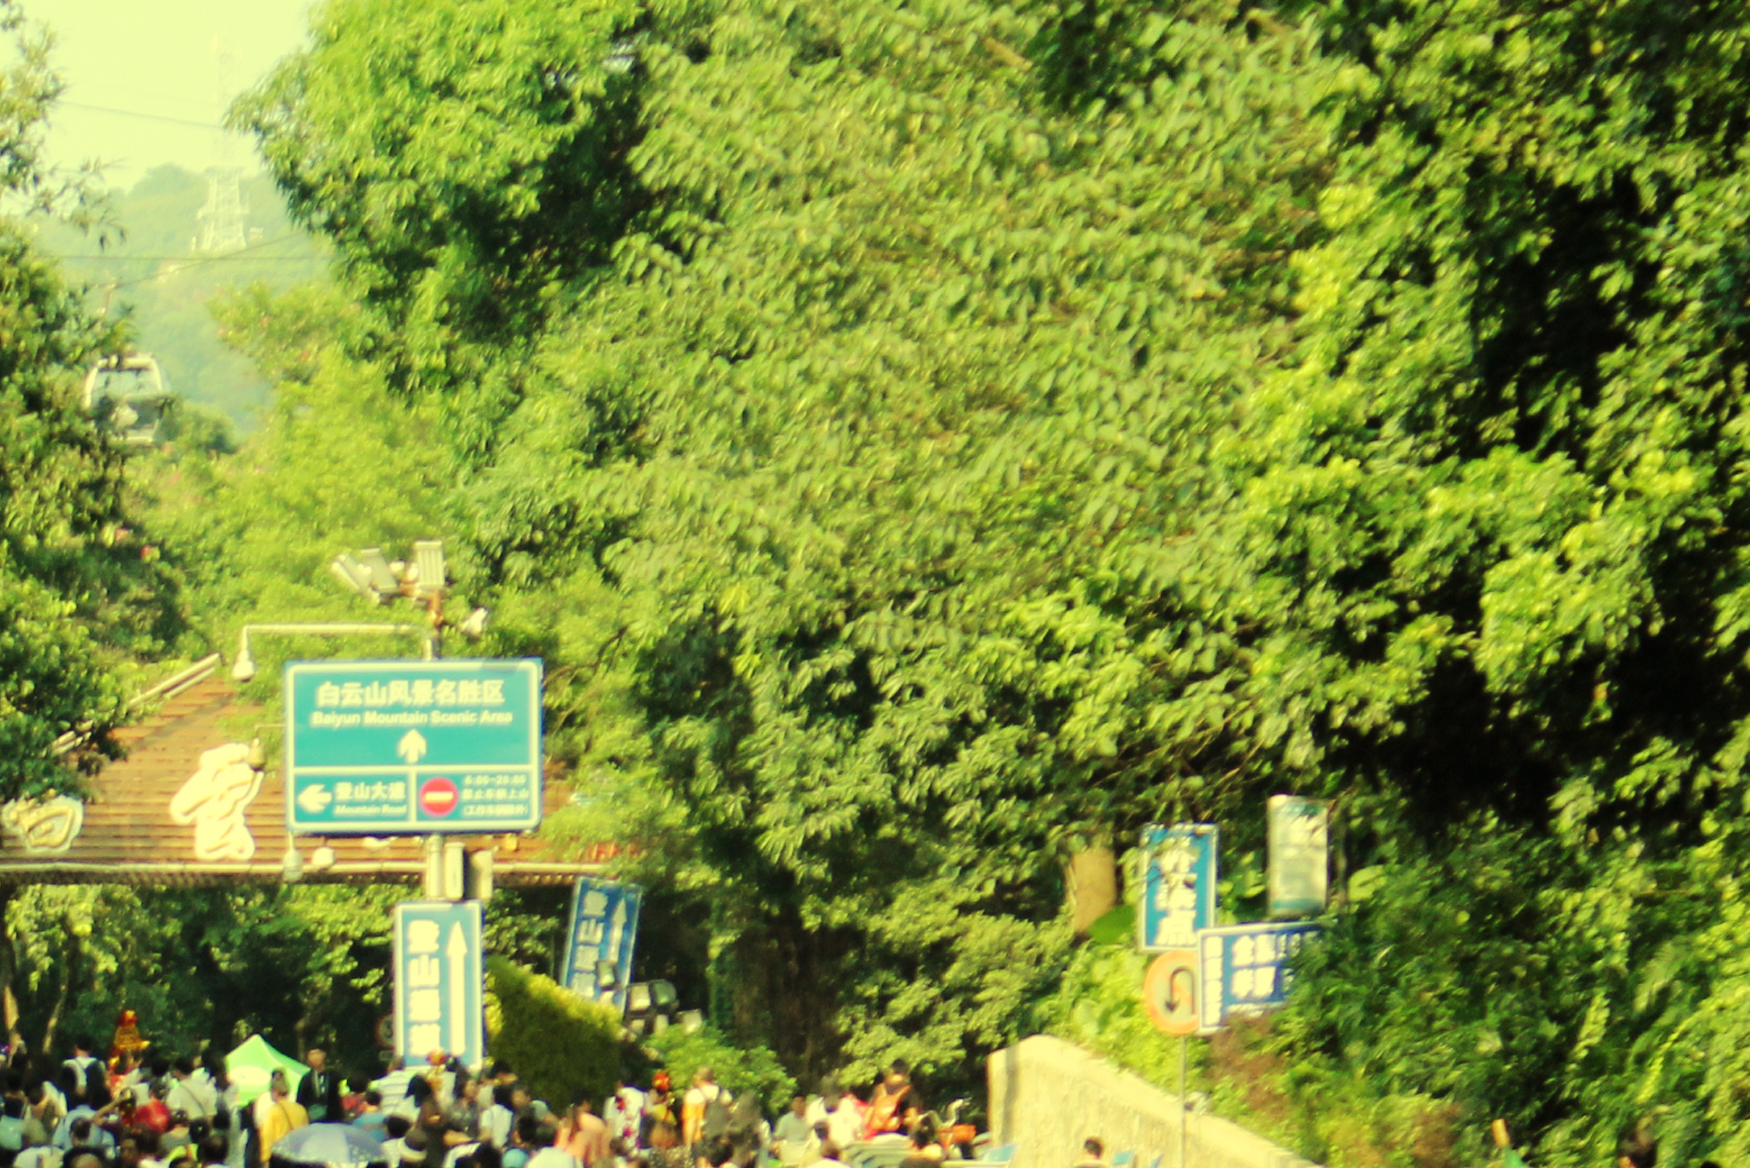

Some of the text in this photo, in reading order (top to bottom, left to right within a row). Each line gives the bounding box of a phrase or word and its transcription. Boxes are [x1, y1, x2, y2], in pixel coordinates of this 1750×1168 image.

[316, 679, 506, 708] 白云山风景名胜区
[311, 708, 514, 731] Baiyun Mountain Scenic Area
[333, 781, 406, 802] 登山大道
